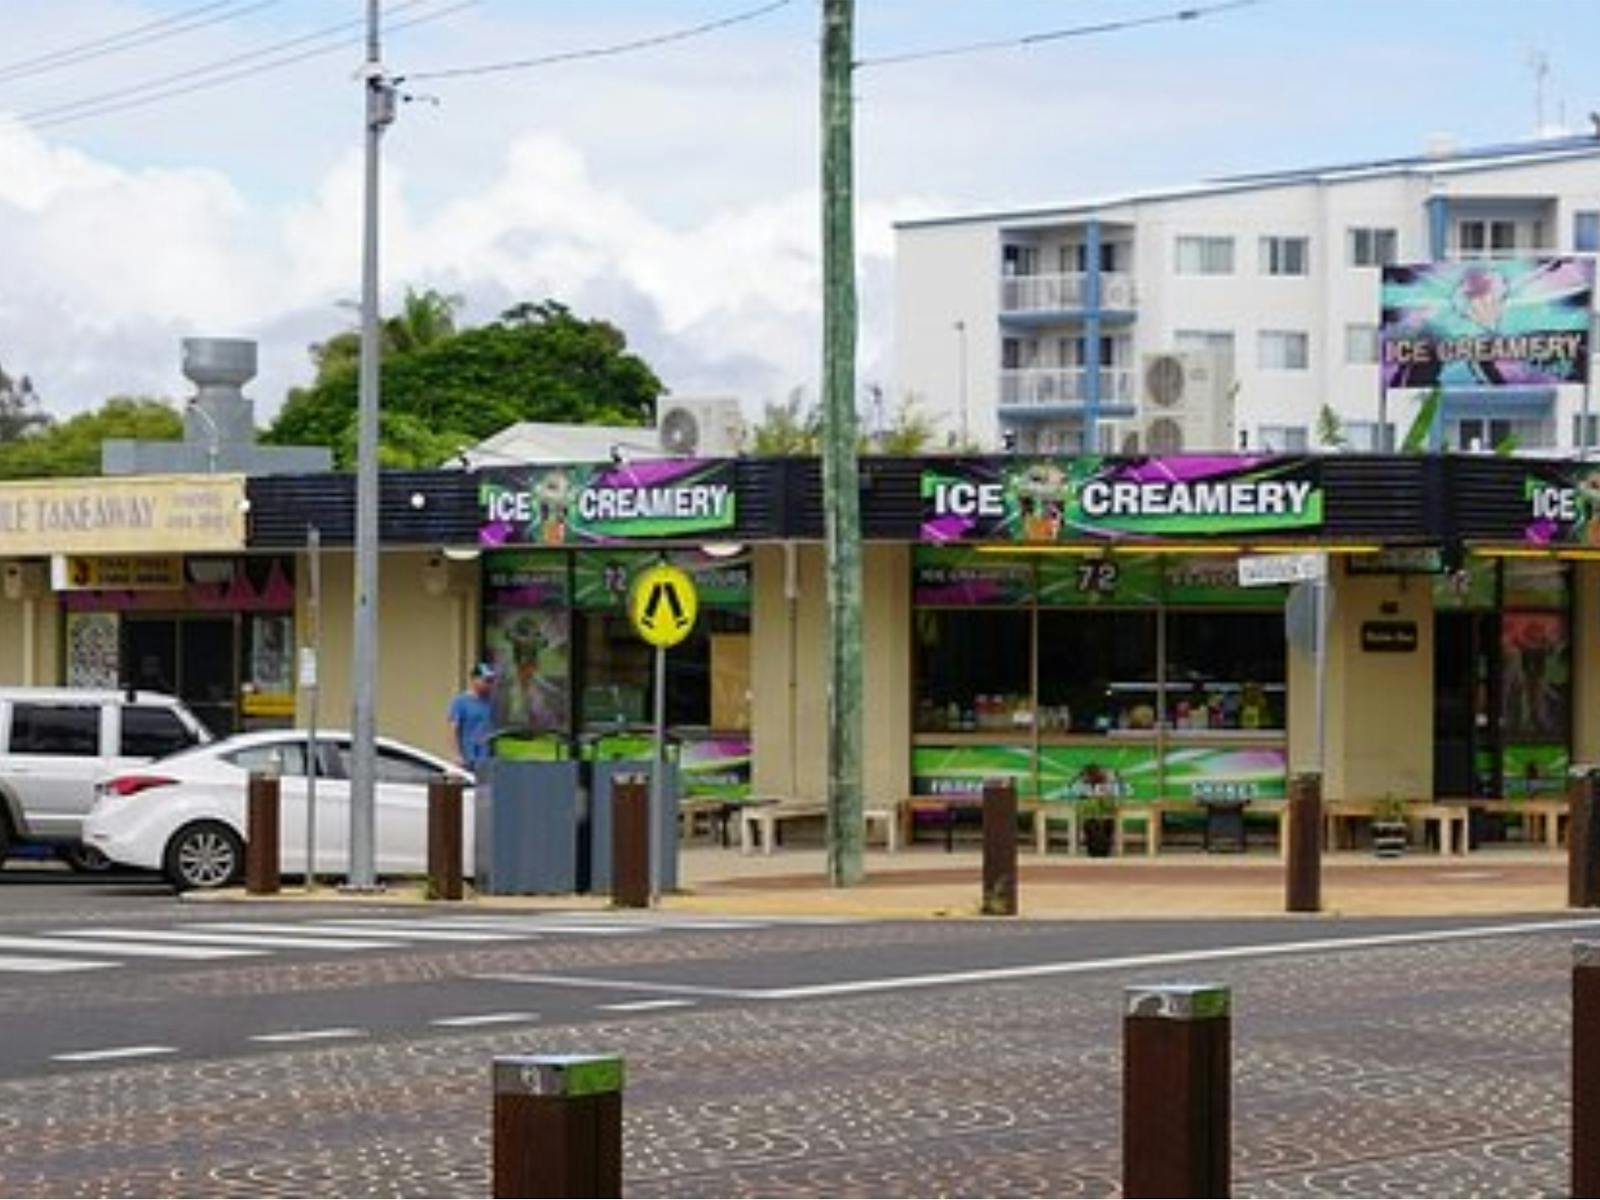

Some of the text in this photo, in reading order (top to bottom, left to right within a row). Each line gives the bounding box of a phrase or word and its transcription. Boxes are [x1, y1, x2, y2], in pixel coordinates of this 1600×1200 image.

[1386, 334, 1581, 363] ICE CREAMERY
[488, 484, 728, 521] ICE CREAMERY
[935, 478, 1311, 515] ICE CREAMERY
[1533, 488, 1575, 520] ICE
[35, 497, 156, 532] TAKEAWAY
[1078, 565, 1116, 590] 72
